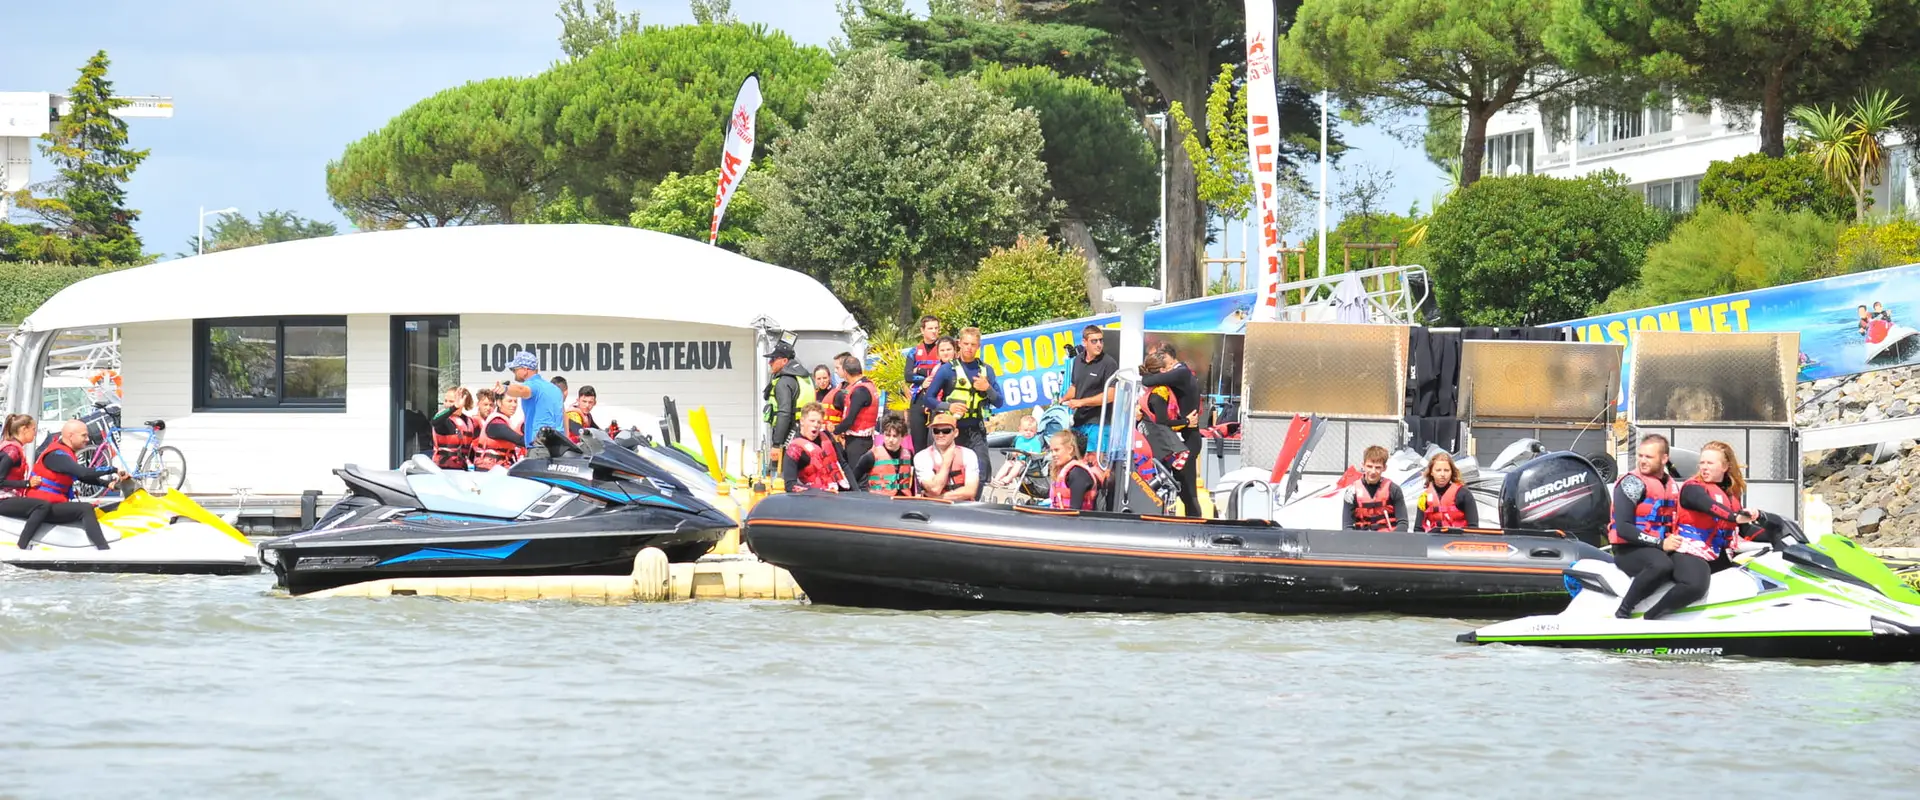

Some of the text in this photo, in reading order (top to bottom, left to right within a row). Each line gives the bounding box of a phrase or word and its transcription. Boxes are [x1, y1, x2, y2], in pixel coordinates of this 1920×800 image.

[597, 342, 624, 371] DE
[630, 341, 733, 371] BATEAUX
[1003, 375, 1038, 407] 69
[1524, 471, 1588, 503] MERCURY
